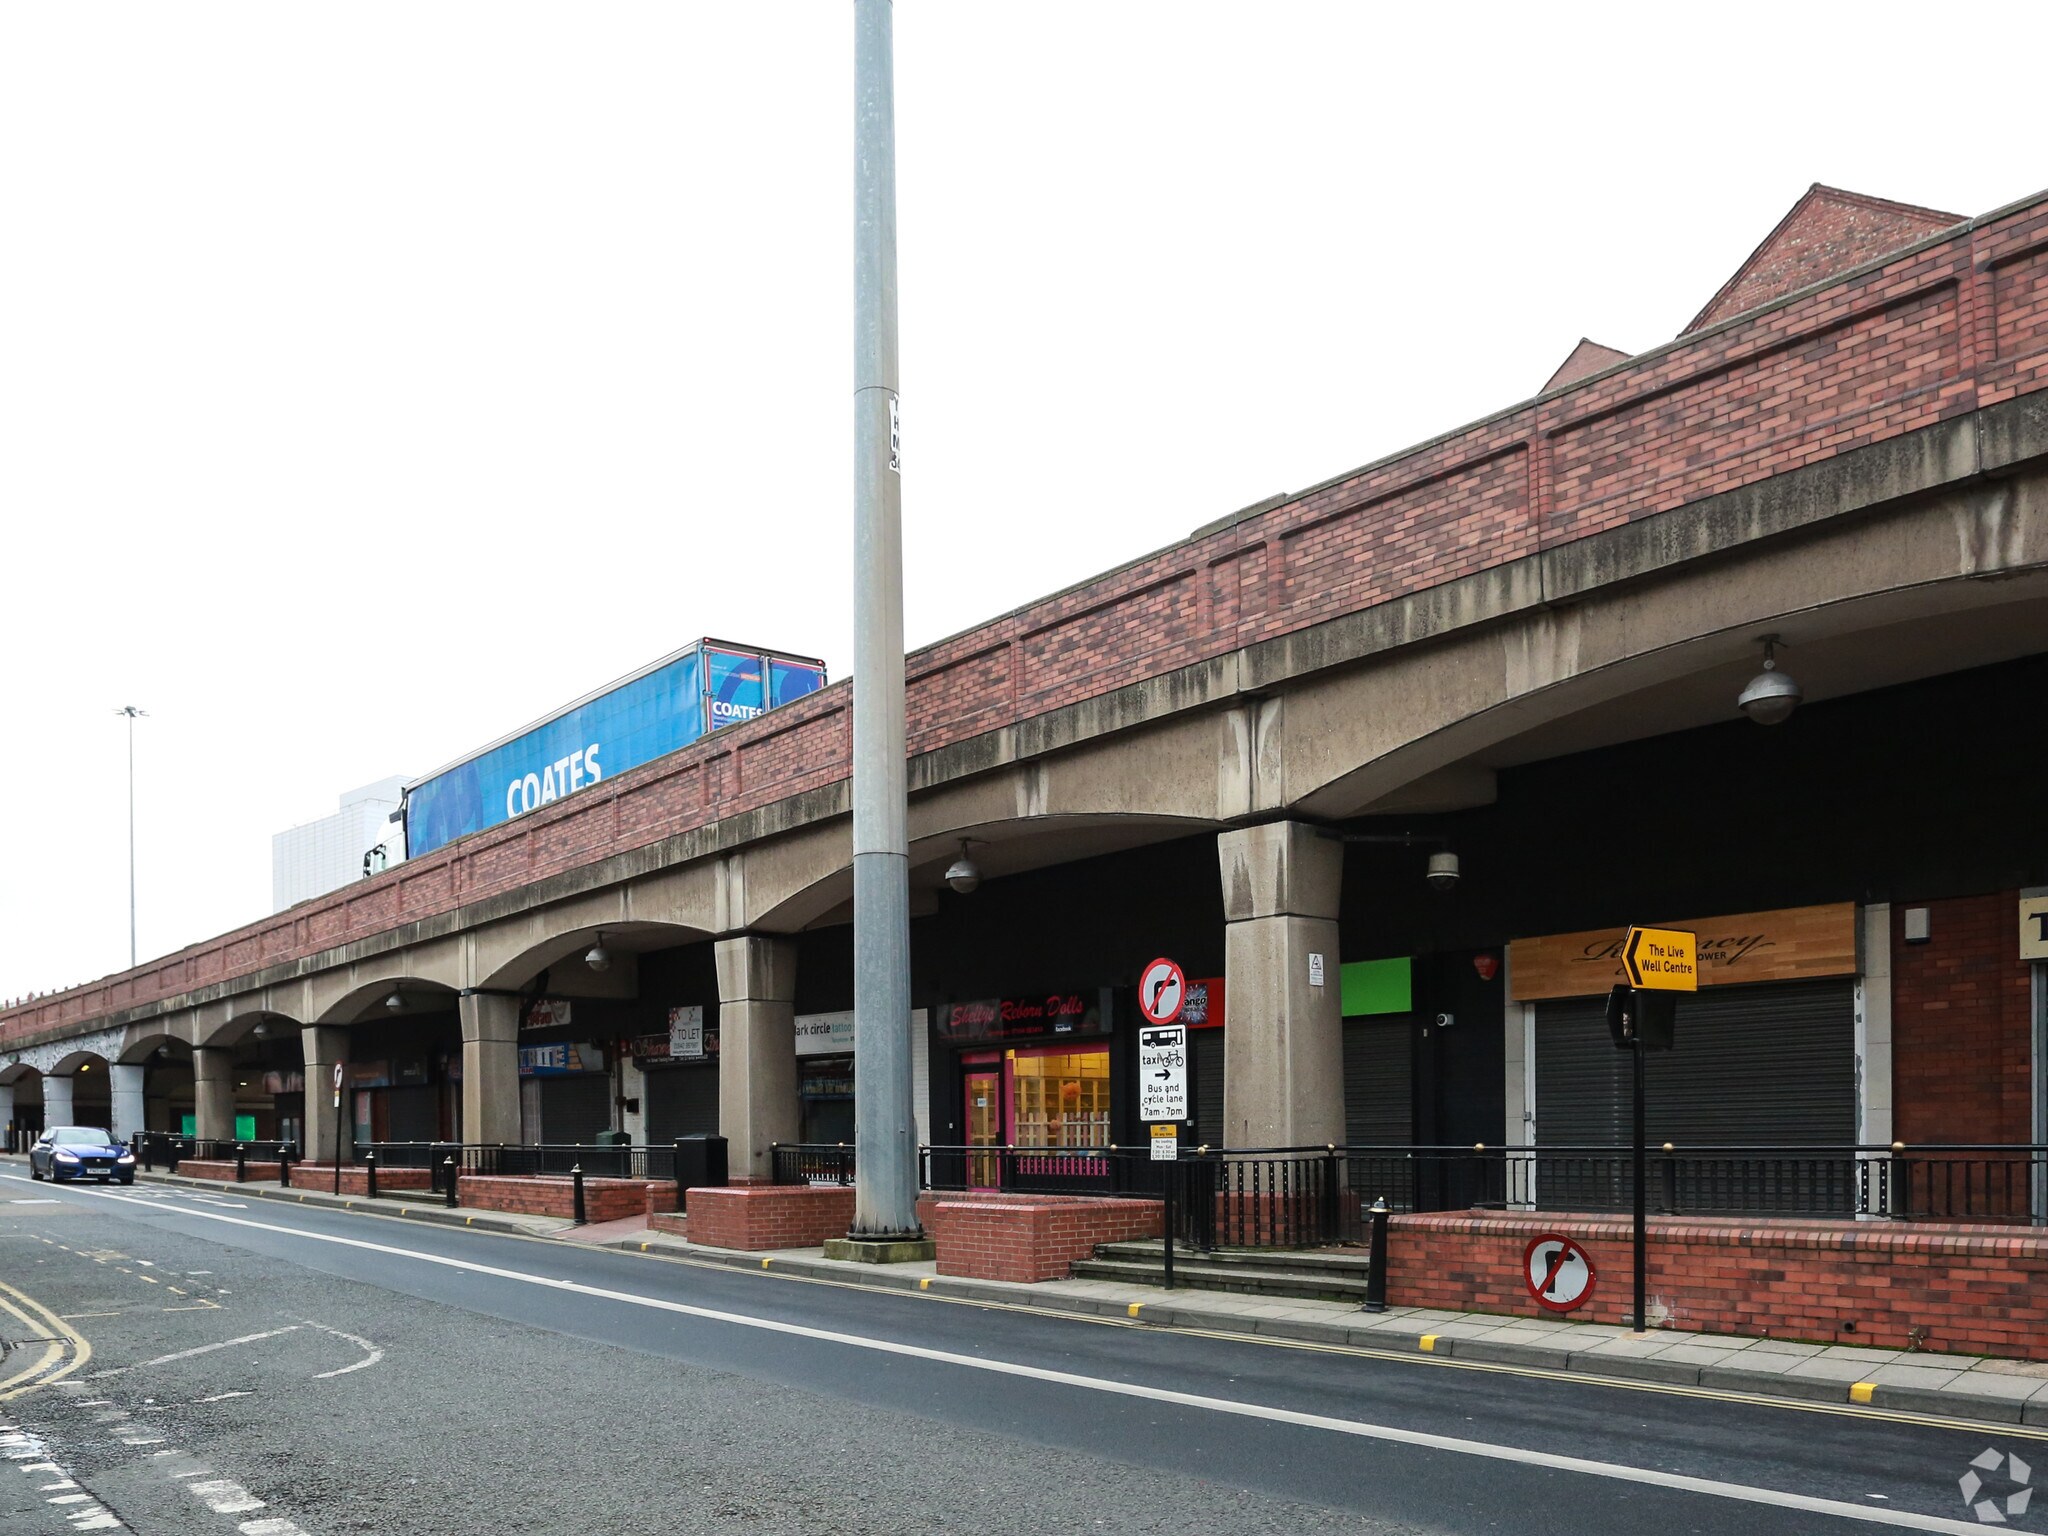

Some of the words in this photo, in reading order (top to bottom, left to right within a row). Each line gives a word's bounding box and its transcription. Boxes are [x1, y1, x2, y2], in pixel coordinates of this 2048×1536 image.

[712, 701, 763, 719] COATES
[507, 743, 602, 819] COATES
[1649, 943, 1665, 957] The
[1667, 945, 1685, 958] Live
[1697, 951, 1726, 961] OWER
[1641, 960, 1661, 972] Well
[1663, 961, 1692, 974] Centre
[1000, 1001, 1043, 1020] Reborn
[1046, 995, 1084, 1016] Dolls
[1184, 997, 1207, 1006] ango
[677, 1028, 687, 1040] TO
[688, 1028, 700, 1039] LET
[795, 1024, 808, 1036] ark
[810, 1022, 830, 1035] circle
[832, 1023, 852, 1033] tattoo
[1142, 1055, 1159, 1065] taxi
[1148, 1084, 1162, 1093] Bus
[1165, 1083, 1179, 1092] and
[1143, 1095, 1164, 1105] cycle
[1166, 1094, 1183, 1103] lane
[1144, 1107, 1160, 1116] 7am
[1166, 1107, 1183, 1117] 7pm
